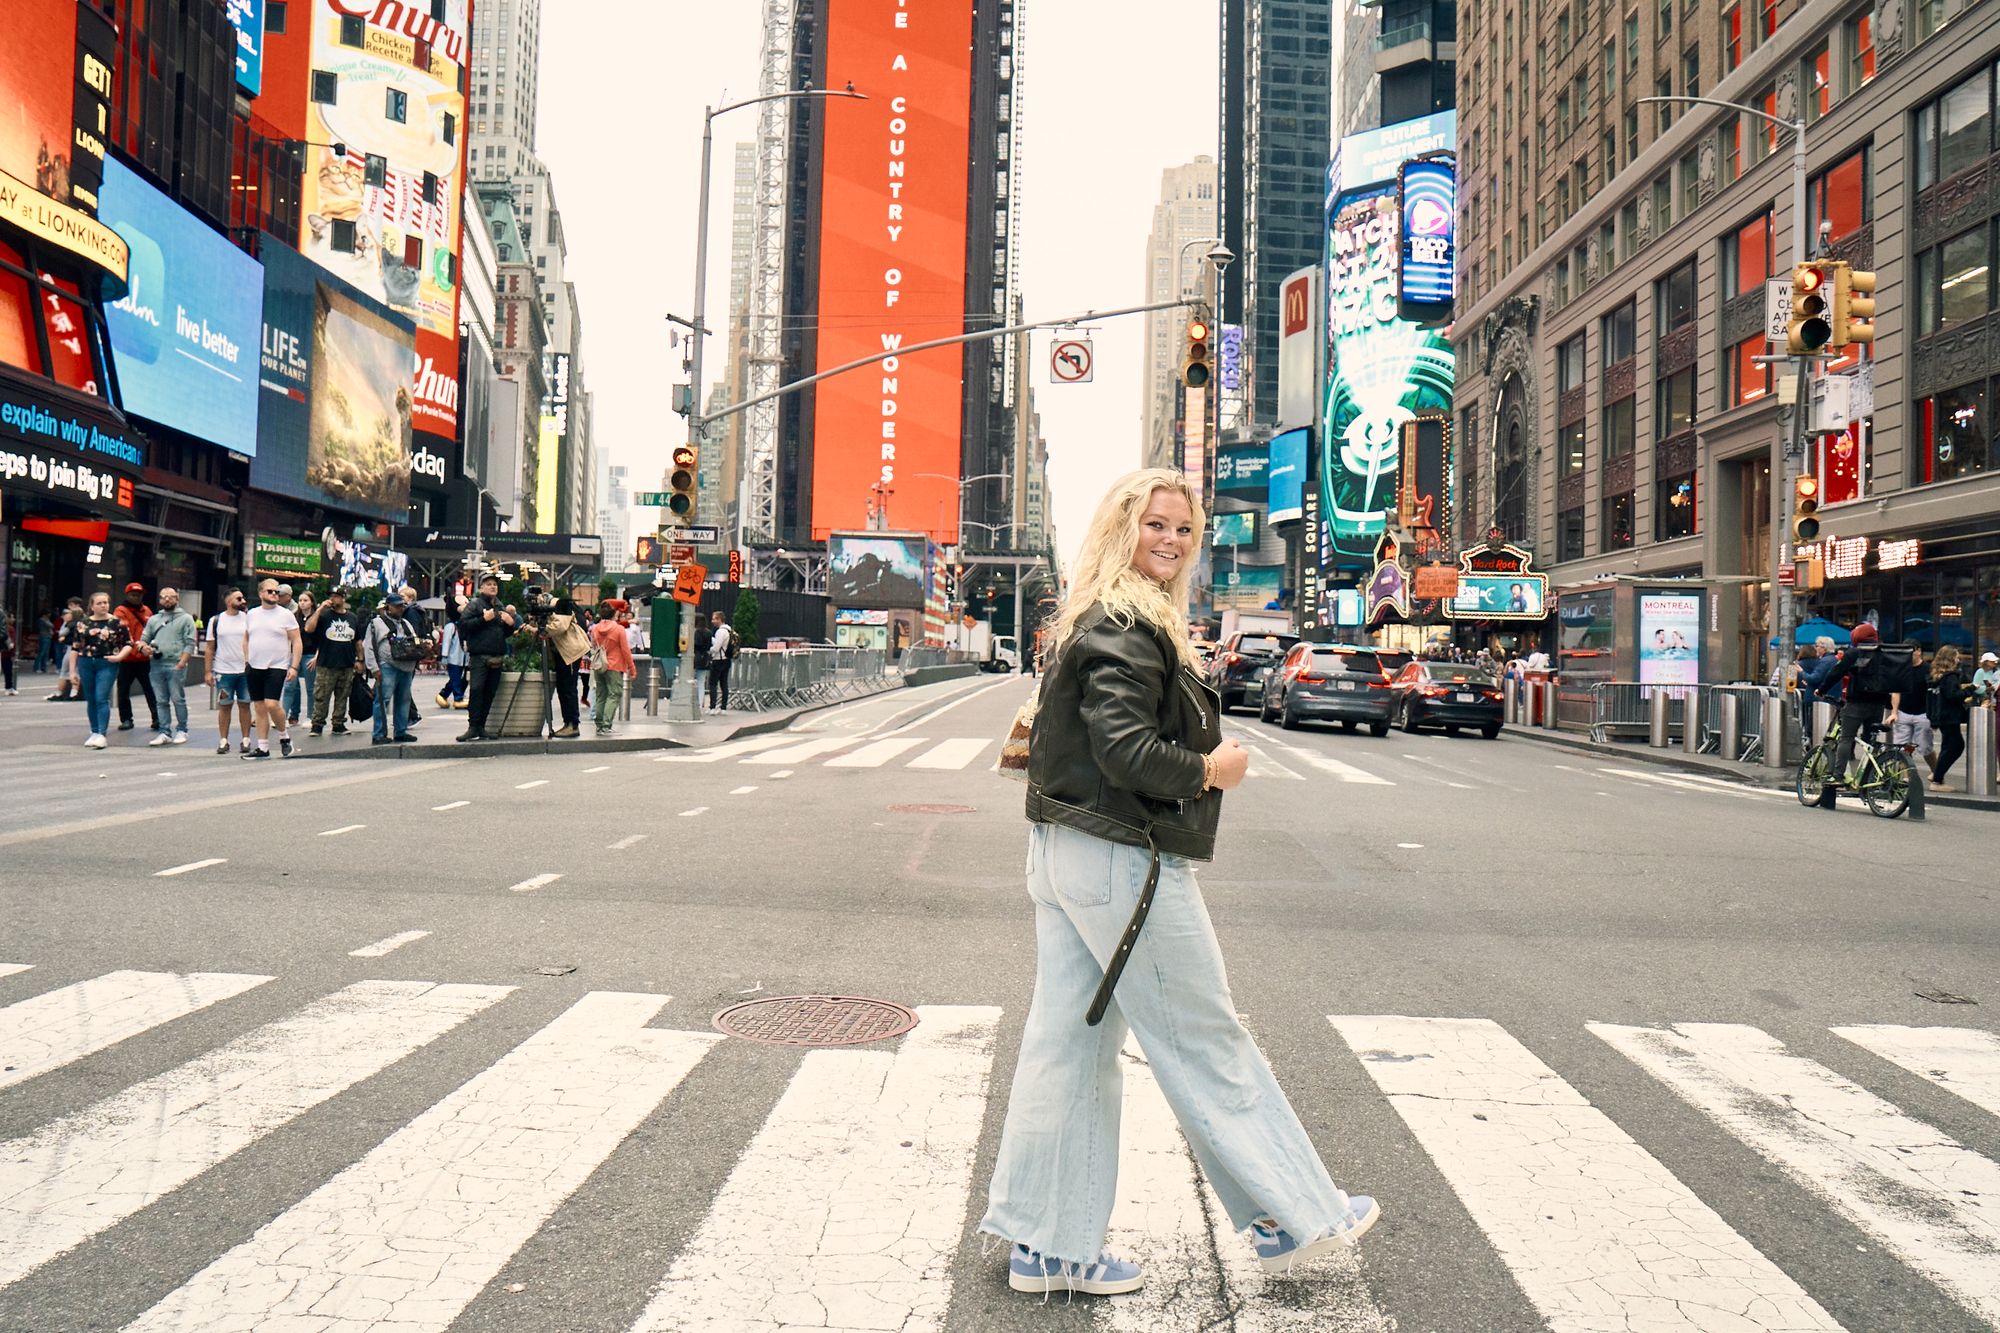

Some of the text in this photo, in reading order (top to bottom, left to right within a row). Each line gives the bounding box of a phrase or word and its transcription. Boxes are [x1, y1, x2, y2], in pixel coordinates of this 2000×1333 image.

[365, 41, 404, 61] Recette
[371, 32, 411, 54] Chicken
[892, 54, 908, 71] A
[887, 96, 907, 242] COUNTRY
[0, 186, 18, 209] AY
[22, 205, 33, 220] at
[1409, 237, 1448, 252] TACO
[1412, 249, 1449, 265] BELL
[884, 268, 902, 307] OF
[176, 304, 240, 363] live better
[262, 322, 299, 367] LIFE
[261, 354, 307, 382] OUR PLANET
[1222, 326, 1243, 389] ROKU
[881, 333, 902, 483] WONDERS
[1, 402, 58, 434] explain
[60, 418, 88, 451] why
[89, 425, 137, 464] American
[0, 450, 28, 479] eps
[30, 454, 47, 481] to
[48, 457, 76, 489] join
[77, 465, 99, 500] Big
[100, 473, 114, 499] 12
[409, 446, 445, 485] sdaq
[645, 494, 654, 504] W
[256, 541, 321, 556] STARBUCKS
[666, 530, 711, 539] ONE WAY
[265, 554, 306, 566] COFFEE
[729, 551, 739, 582] BAR
[1304, 493, 1318, 630] 3 TIMES SQUARE
[1472, 559, 1518, 572] Hard Rock
[702, 582, 720, 590] OGS
[1644, 600, 1695, 609] MONTRÉAL
